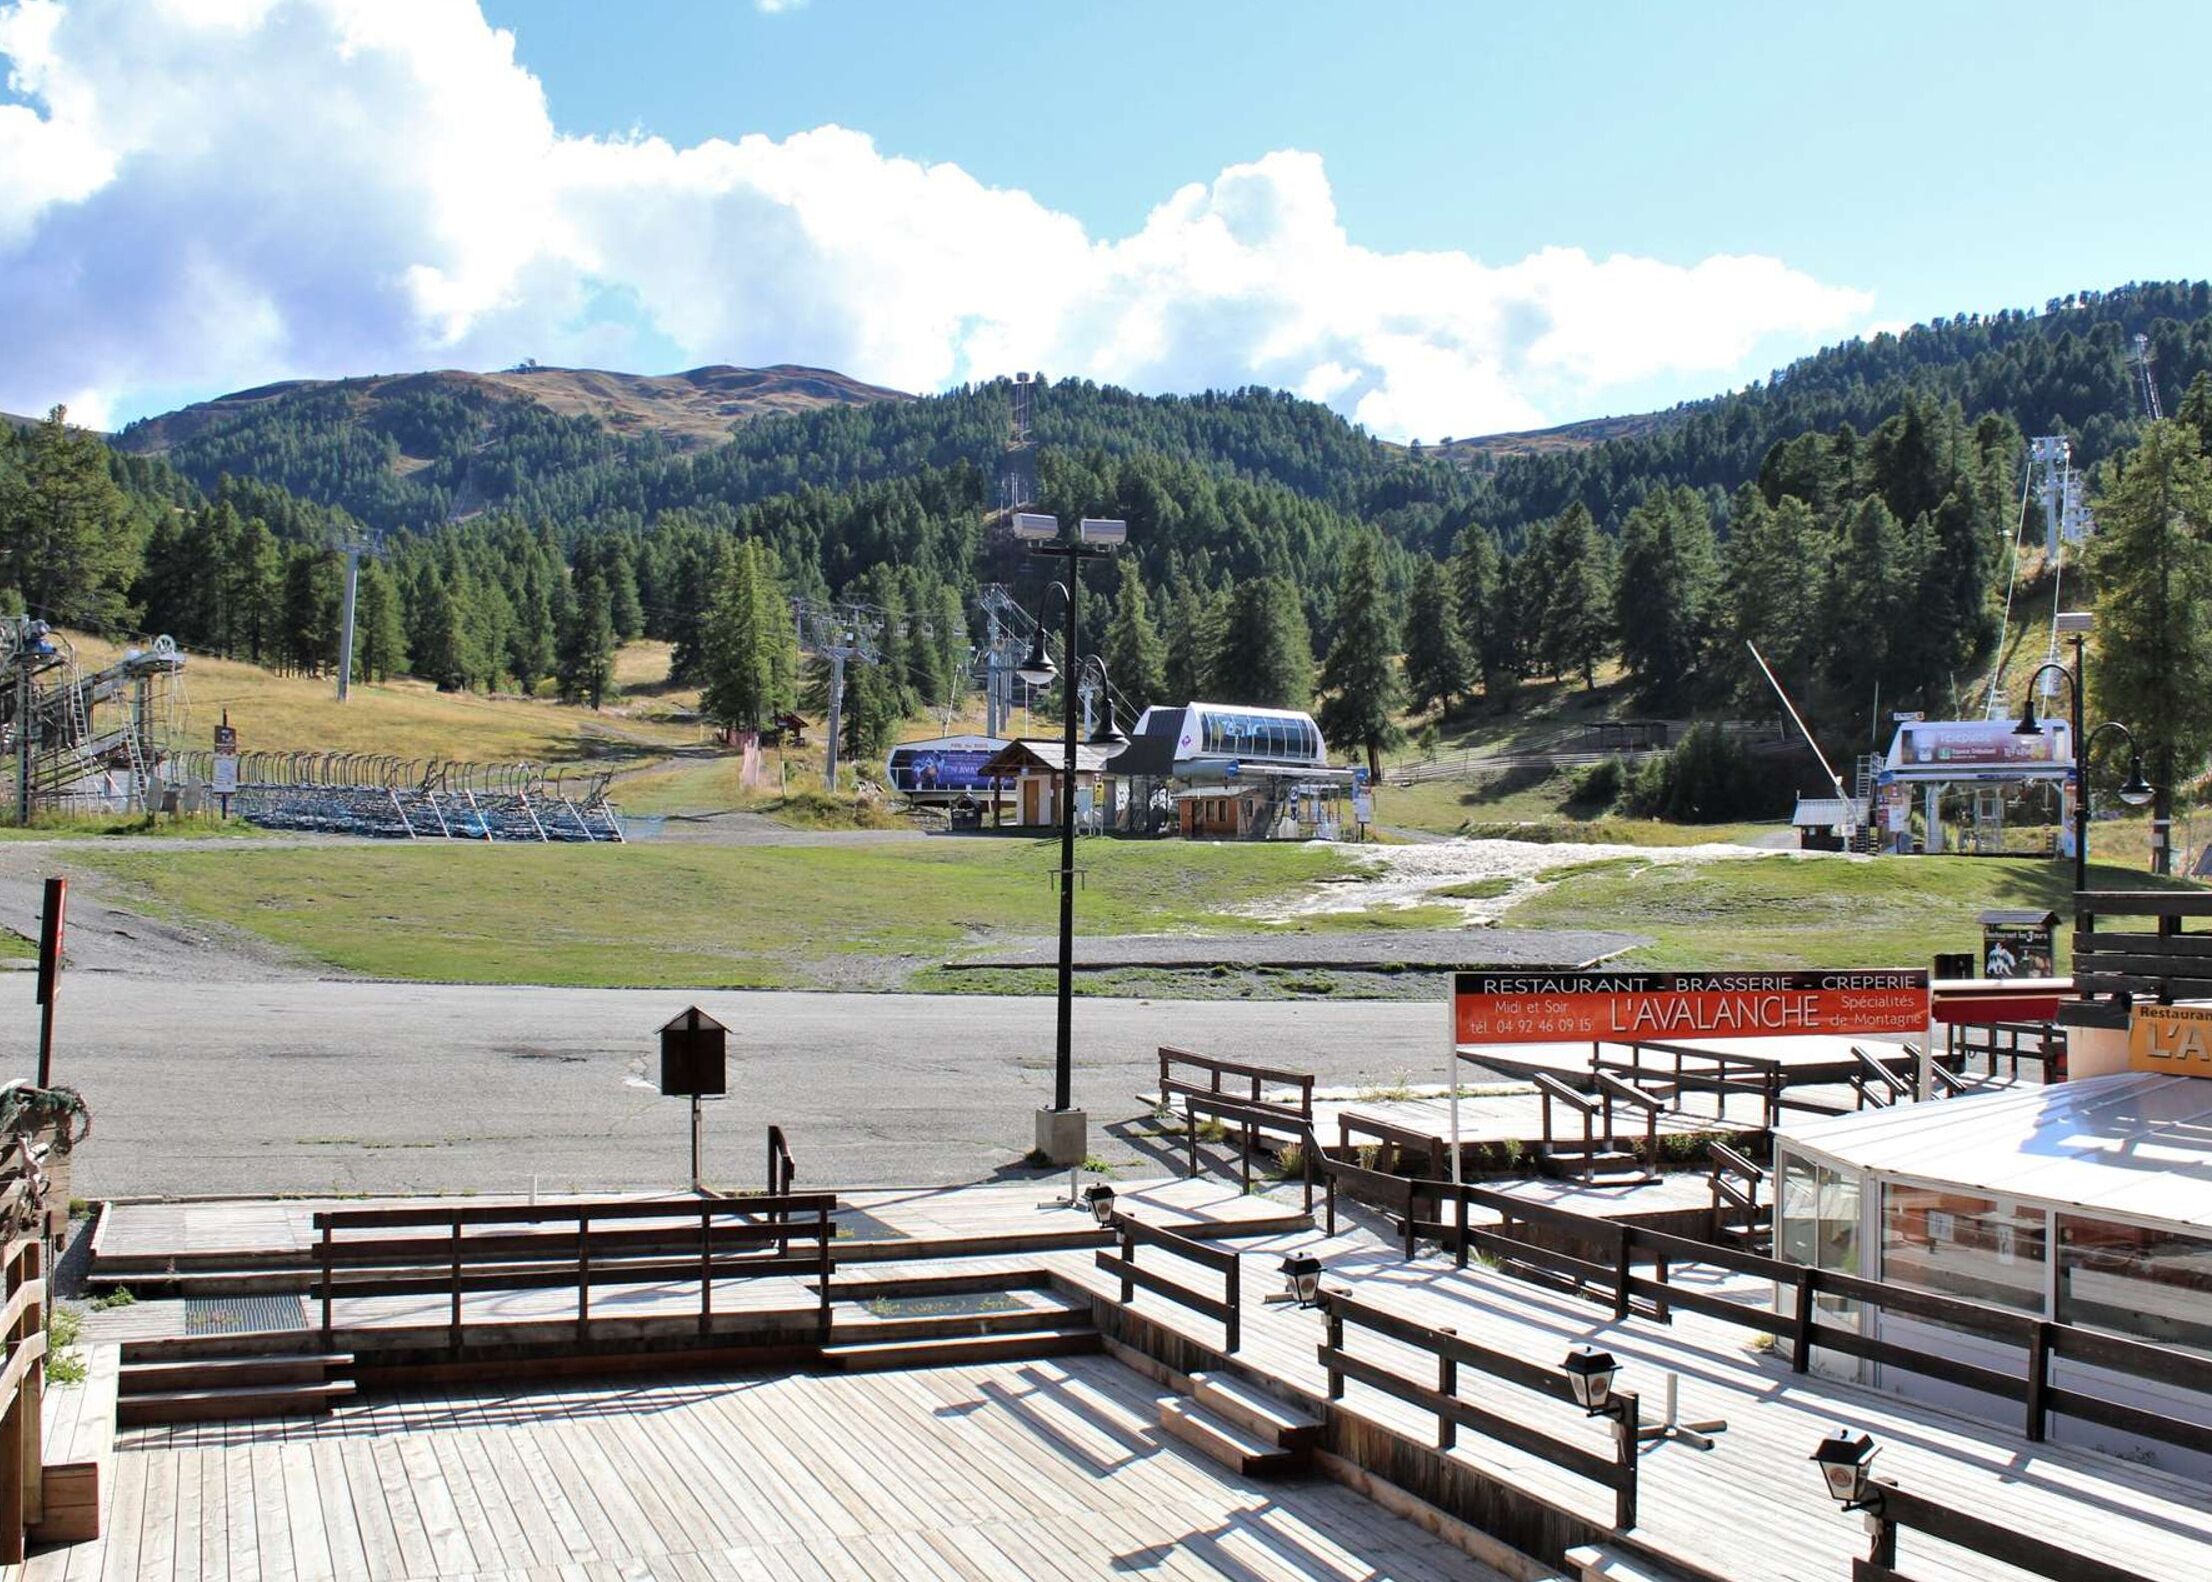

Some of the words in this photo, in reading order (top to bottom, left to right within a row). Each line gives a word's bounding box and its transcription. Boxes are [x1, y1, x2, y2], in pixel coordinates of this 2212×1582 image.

[1484, 978, 1648, 994] RESTAURANT
[1676, 977, 1793, 993] BRASSERIE
[1821, 975, 1917, 991] CREPERIE
[1495, 1001, 1522, 1014] Midi
[1526, 1001, 1540, 1013] et
[1544, 999, 1568, 1013] Soir
[1840, 994, 1916, 1010] Spécialités
[1611, 995, 1820, 1032] L'AVALANCHE
[1830, 1014, 1848, 1026] de
[1855, 1012, 1923, 1027] Montagne
[1496, 1021, 1513, 1033] 04
[1518, 1020, 1534, 1033] 92
[1538, 1020, 1554, 1033] 46
[1558, 1018, 1574, 1032] 09
[1579, 1018, 1593, 1032] 15
